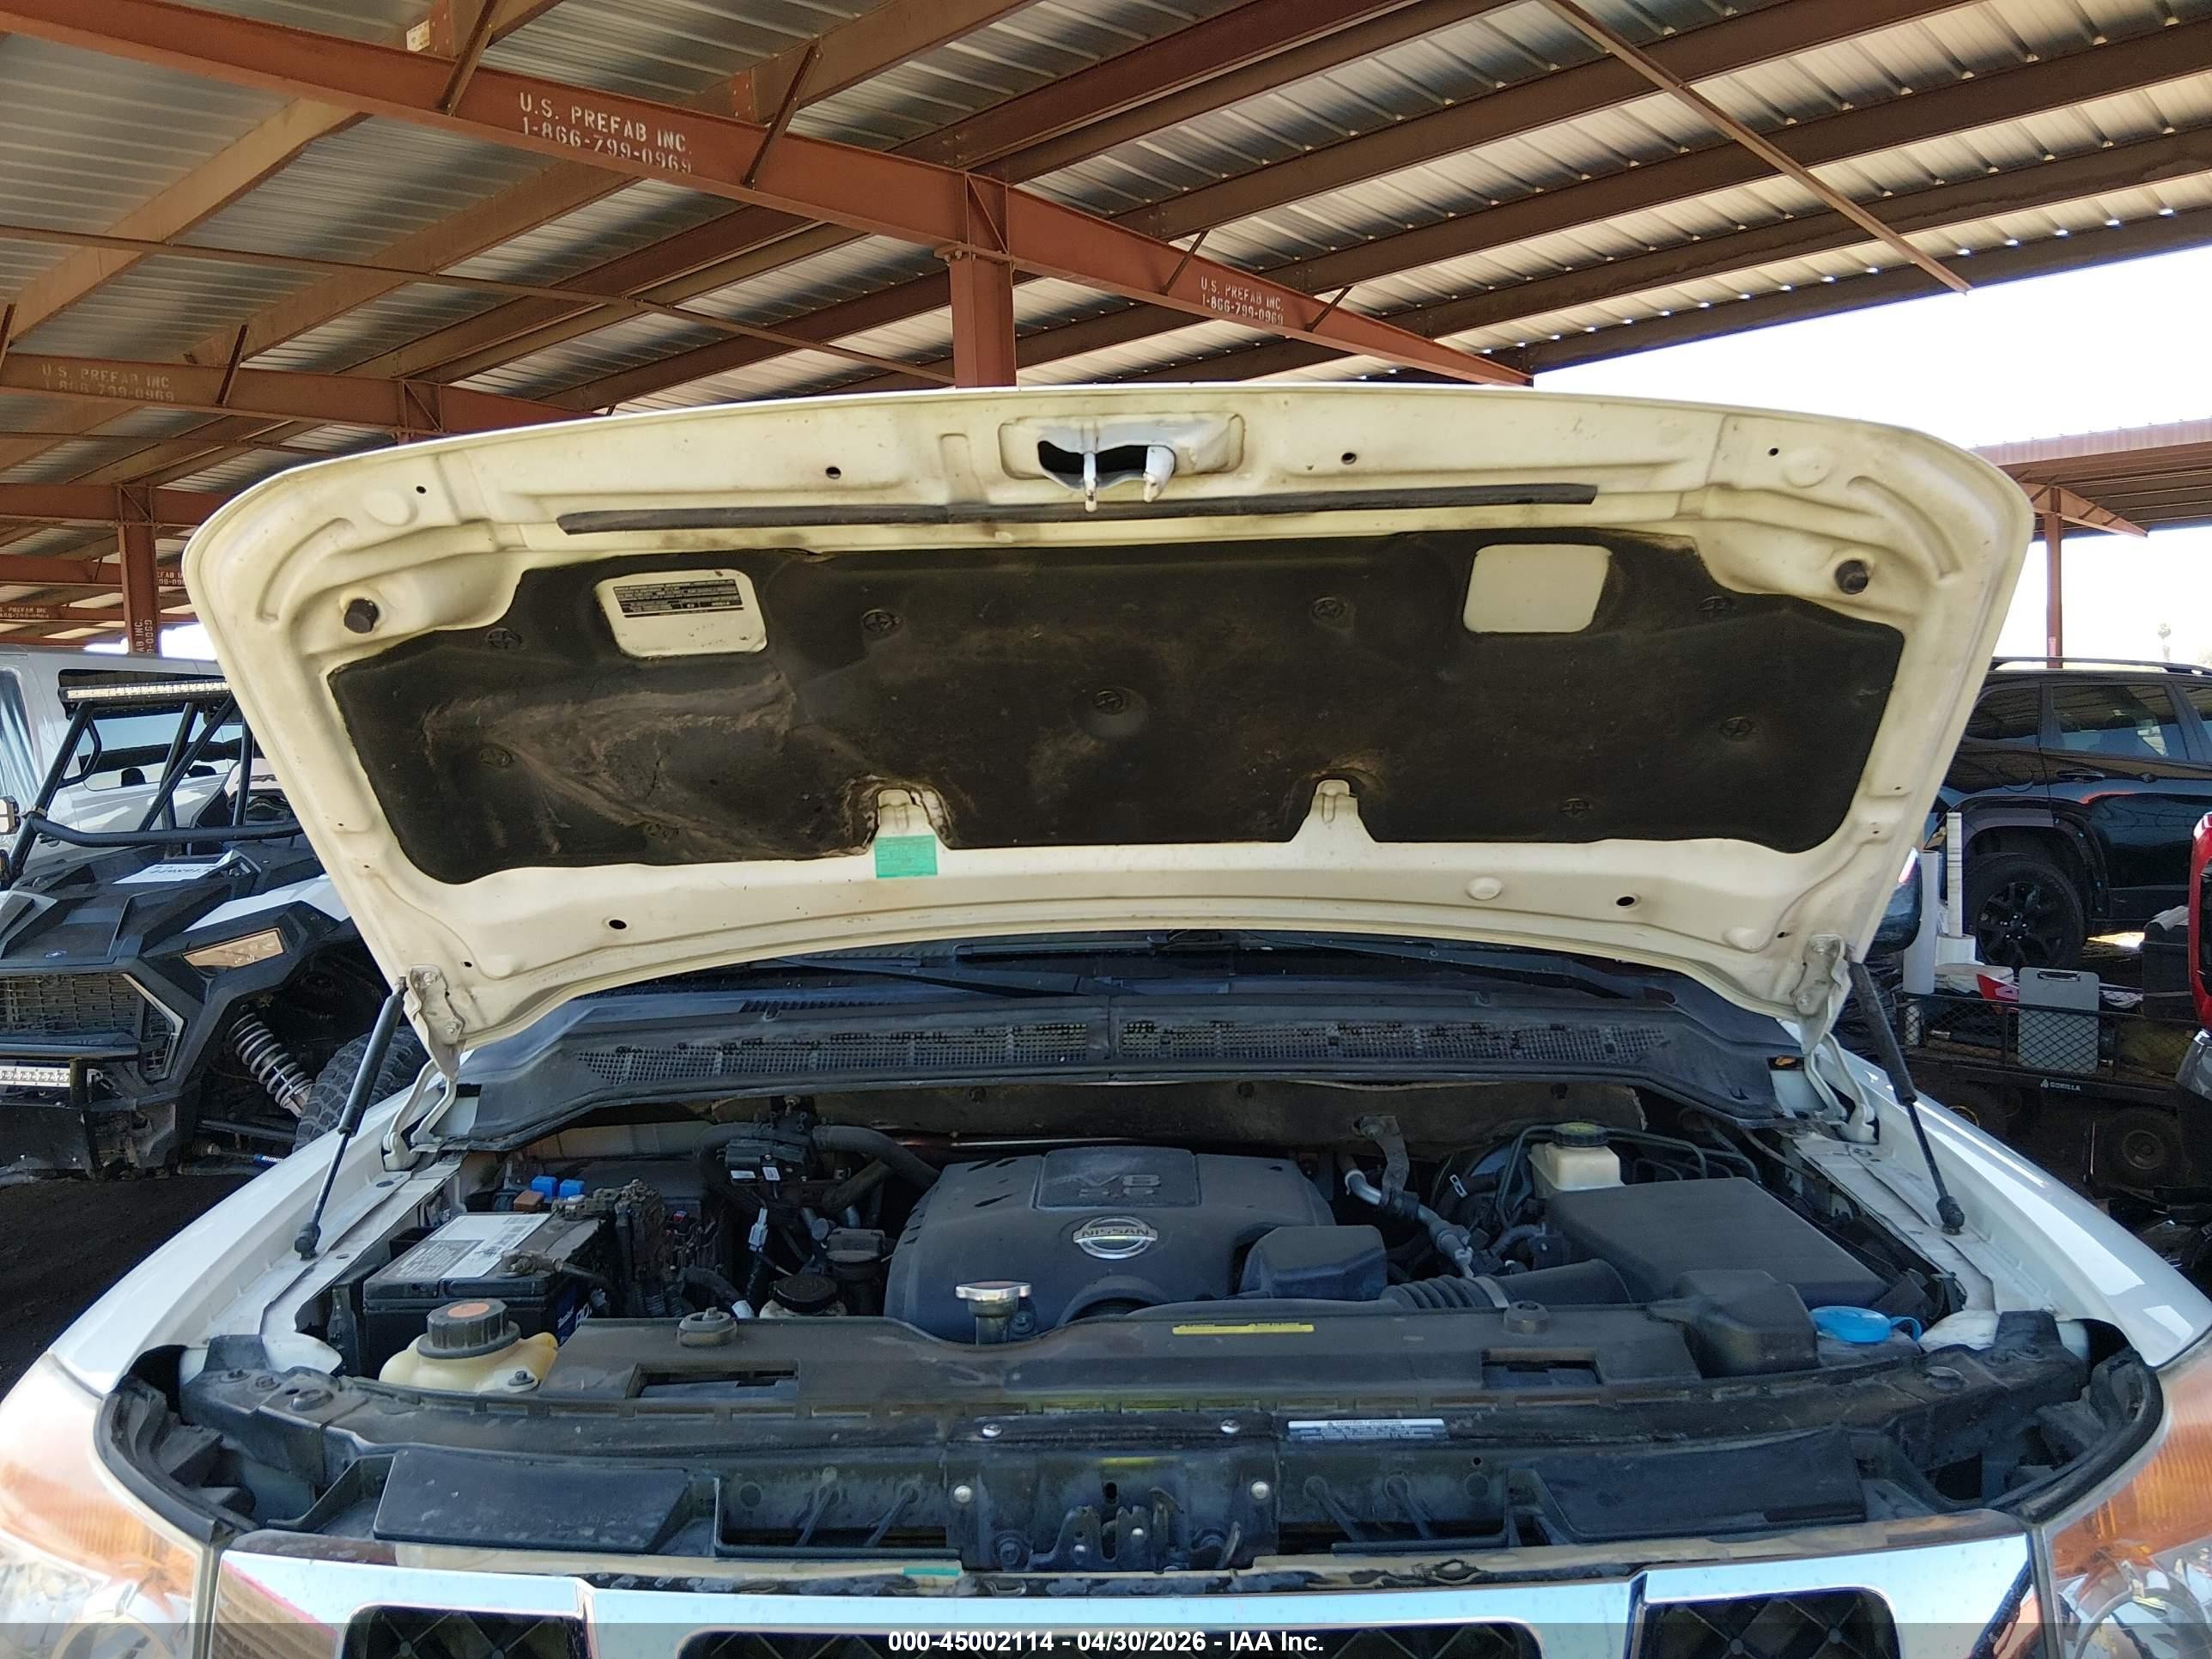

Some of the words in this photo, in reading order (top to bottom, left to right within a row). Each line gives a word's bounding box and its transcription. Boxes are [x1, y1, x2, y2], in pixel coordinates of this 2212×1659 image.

[520, 92, 559, 120] U.S.
[571, 105, 647, 143] PREFAB
[657, 130, 692, 155] INC.
[522, 117, 692, 174] 1-866-799-0969
[1200, 276, 1220, 295] U.S.
[1225, 283, 1262, 306] PREFAB
[1266, 295, 1285, 312] INC.
[1081, 1227, 1150, 1237] NISSAN
